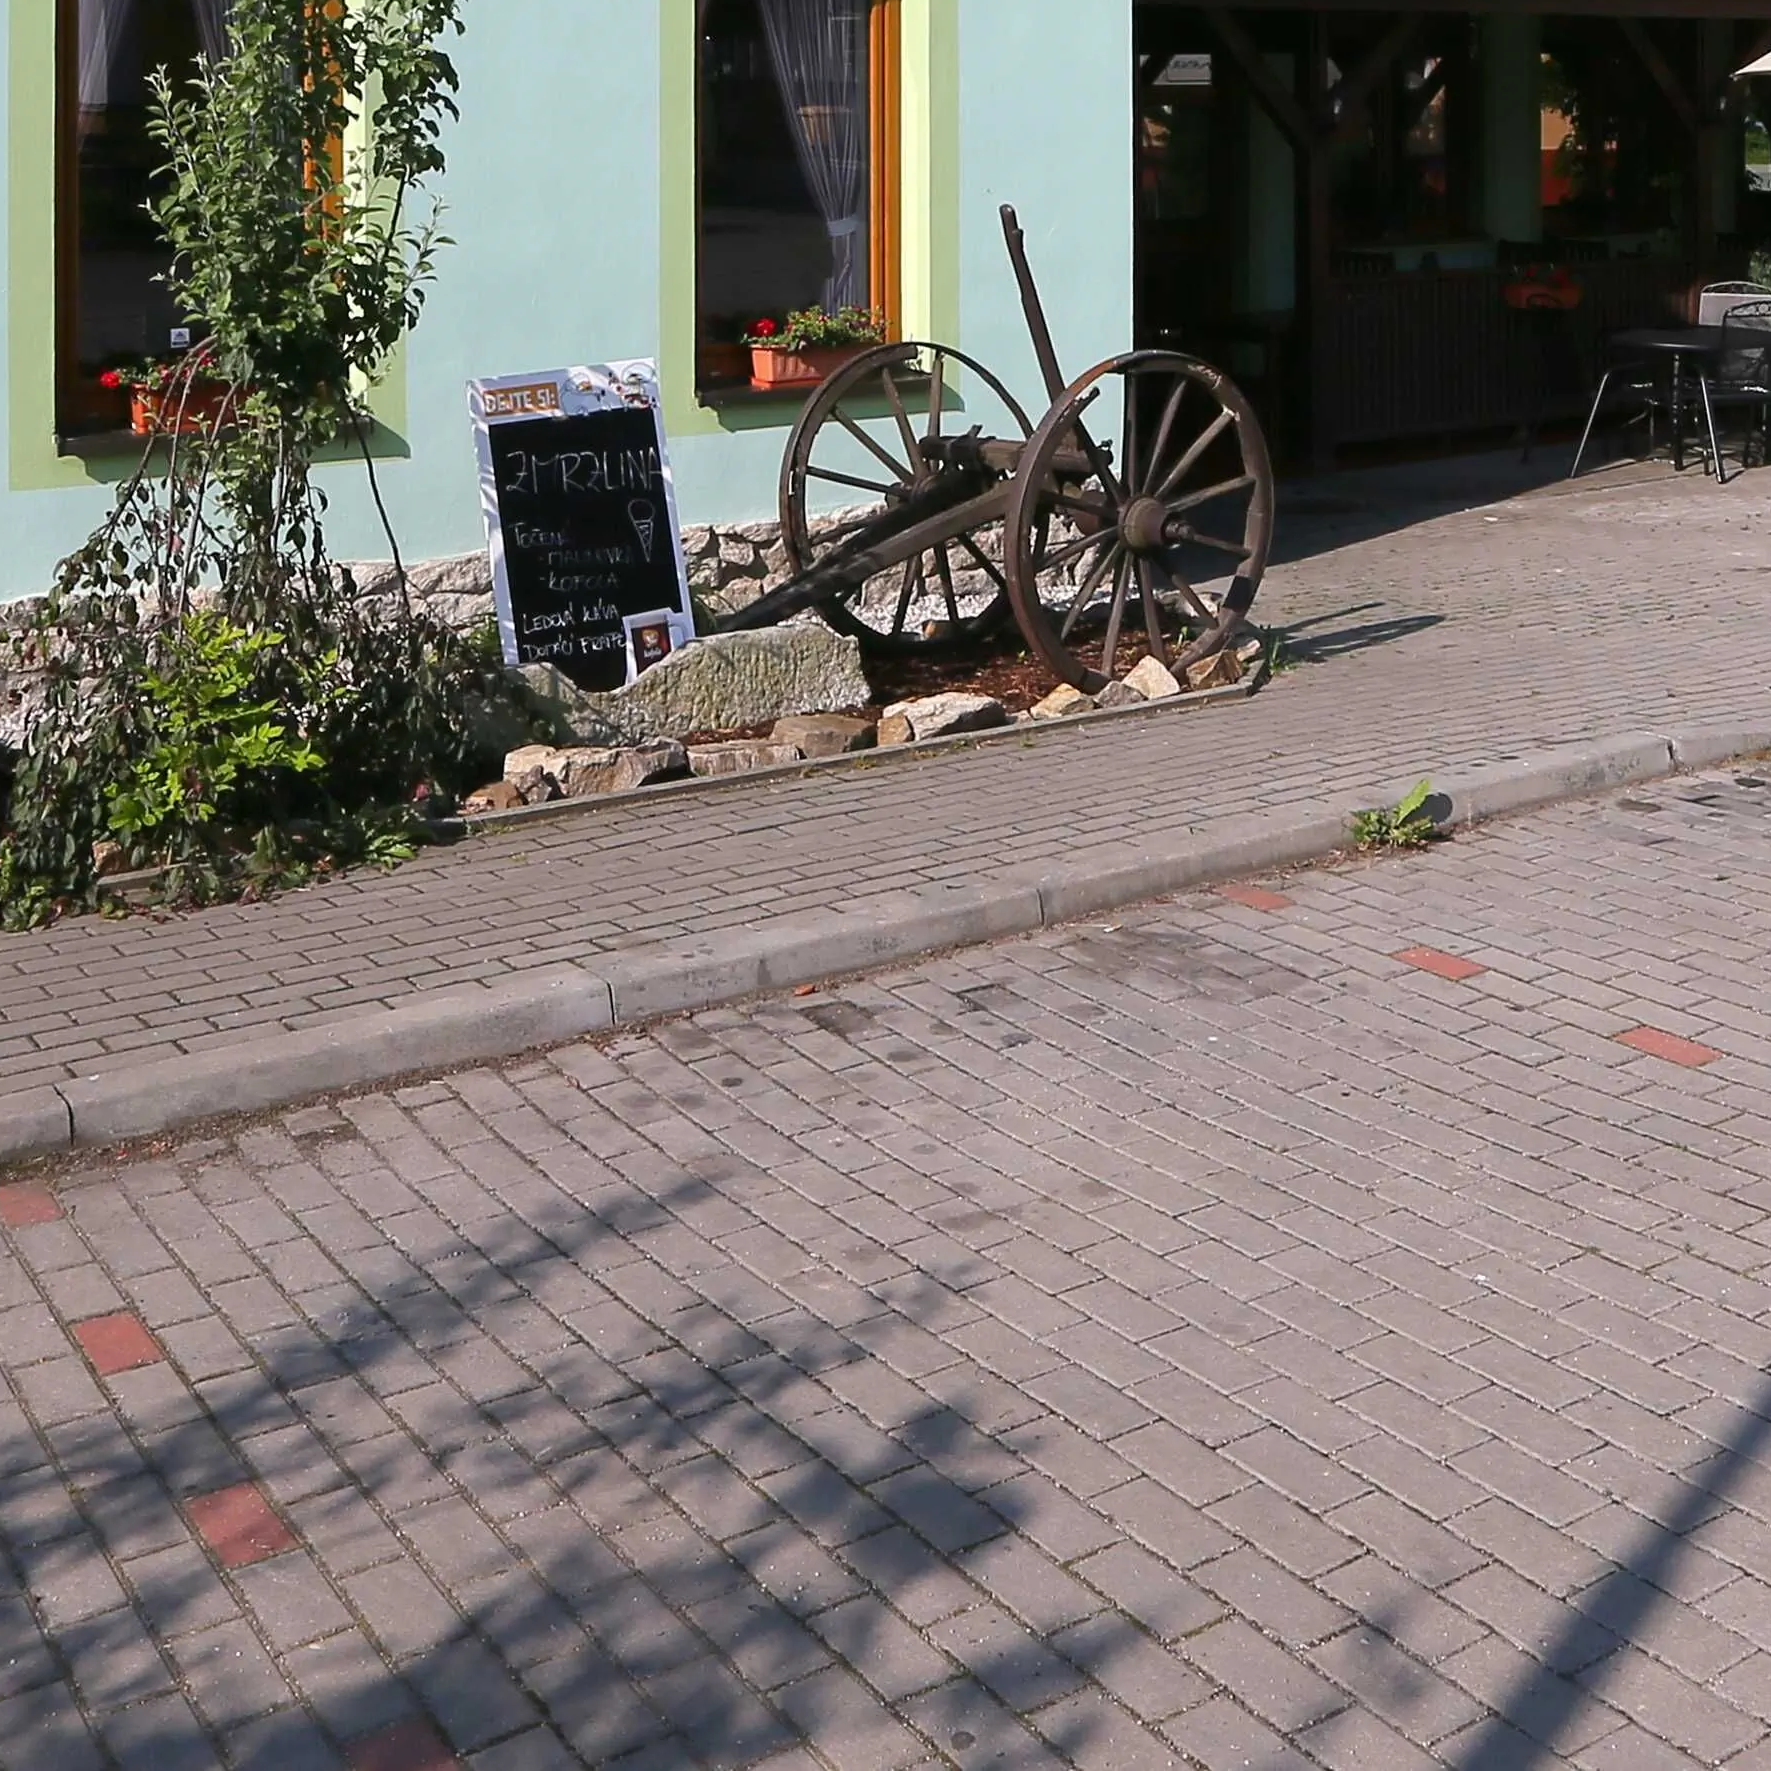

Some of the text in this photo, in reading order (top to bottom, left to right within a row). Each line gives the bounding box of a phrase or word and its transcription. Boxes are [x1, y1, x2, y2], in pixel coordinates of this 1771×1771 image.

[485, 387, 556, 413] DEJTE SI:
[505, 446, 663, 495] ZMRZLINA
